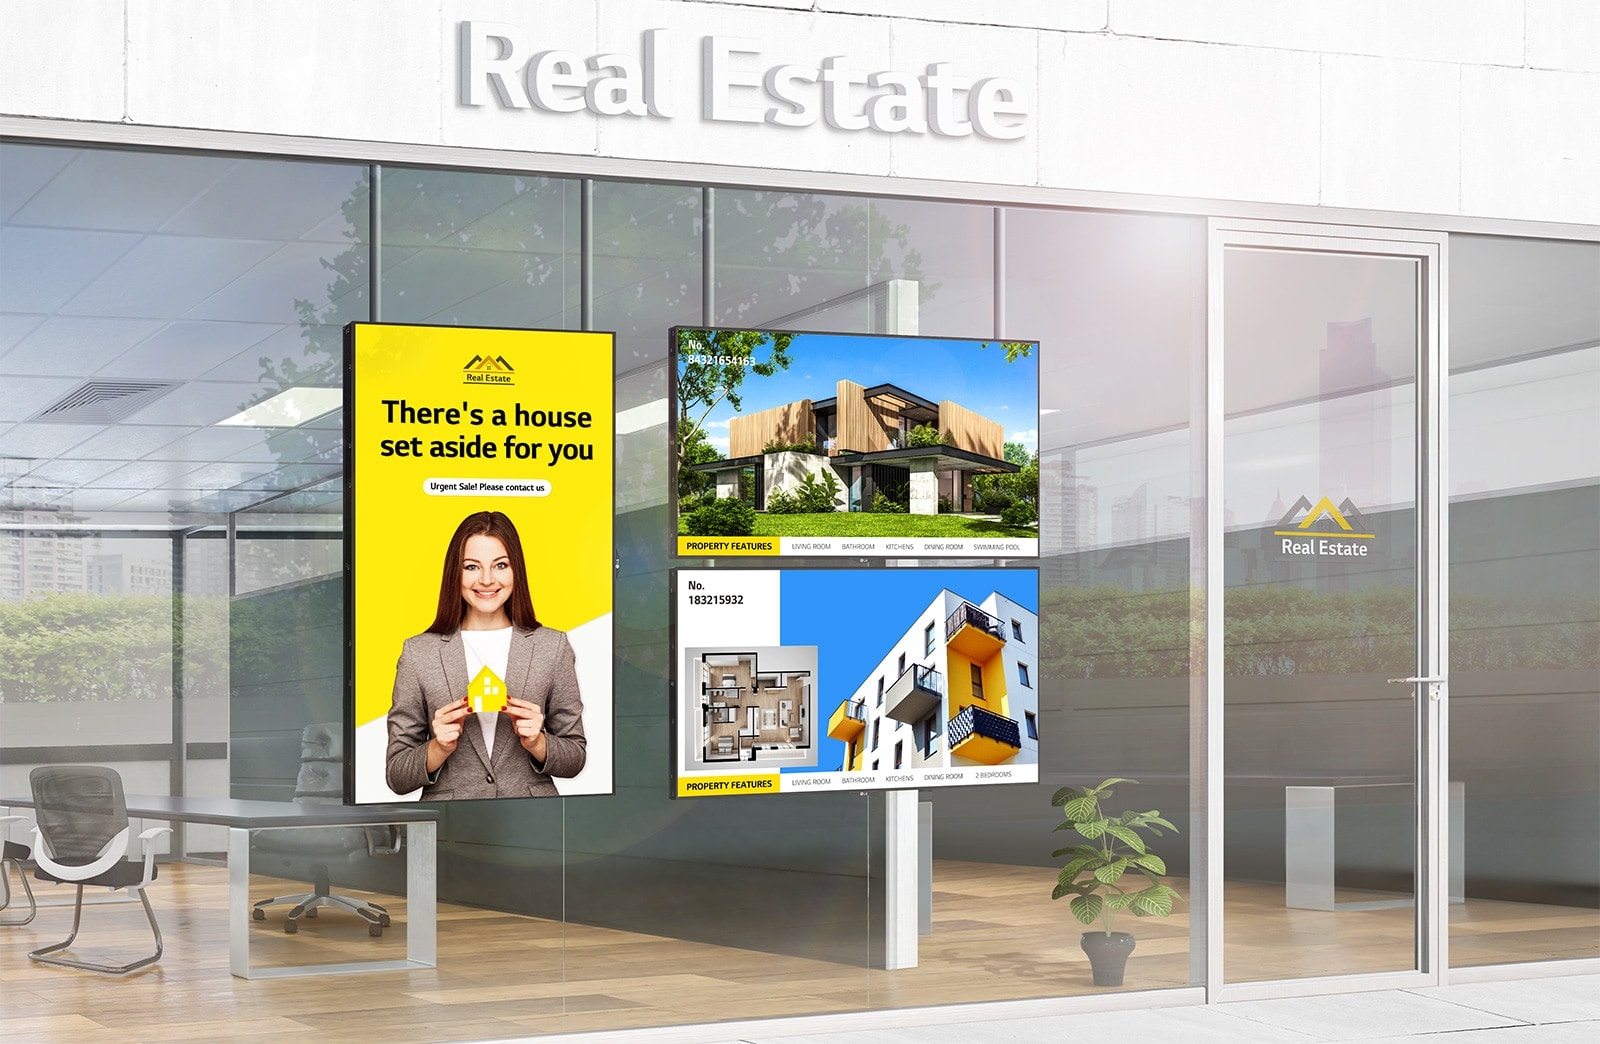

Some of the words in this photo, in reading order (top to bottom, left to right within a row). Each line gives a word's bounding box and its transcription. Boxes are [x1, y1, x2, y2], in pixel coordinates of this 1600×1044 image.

[461, 20, 676, 118] Real
[703, 35, 1029, 140] Estate
[688, 340, 705, 350] No.
[688, 355, 756, 366] 84321654163
[466, 374, 484, 382] Real
[485, 374, 511, 383] Estate
[381, 400, 484, 425] There's
[492, 409, 507, 426] a
[515, 403, 592, 428] house
[380, 437, 423, 457] set
[430, 434, 497, 458] aside
[503, 435, 542, 459] for
[548, 443, 593, 466] you
[430, 482, 457, 492] Urgent
[459, 483, 478, 491] Sale!
[479, 483, 504, 491] Please
[505, 483, 534, 492] contact
[536, 484, 545, 492] us
[686, 542, 730, 550] PROPERTY
[731, 542, 773, 550] FEATURES
[1282, 538, 1315, 555] Real
[1319, 540, 1368, 556] Estate
[688, 580, 705, 590] No.
[688, 595, 744, 605] 183215932
[686, 781, 730, 791] PROPERTY
[731, 780, 773, 789] FEATURES
